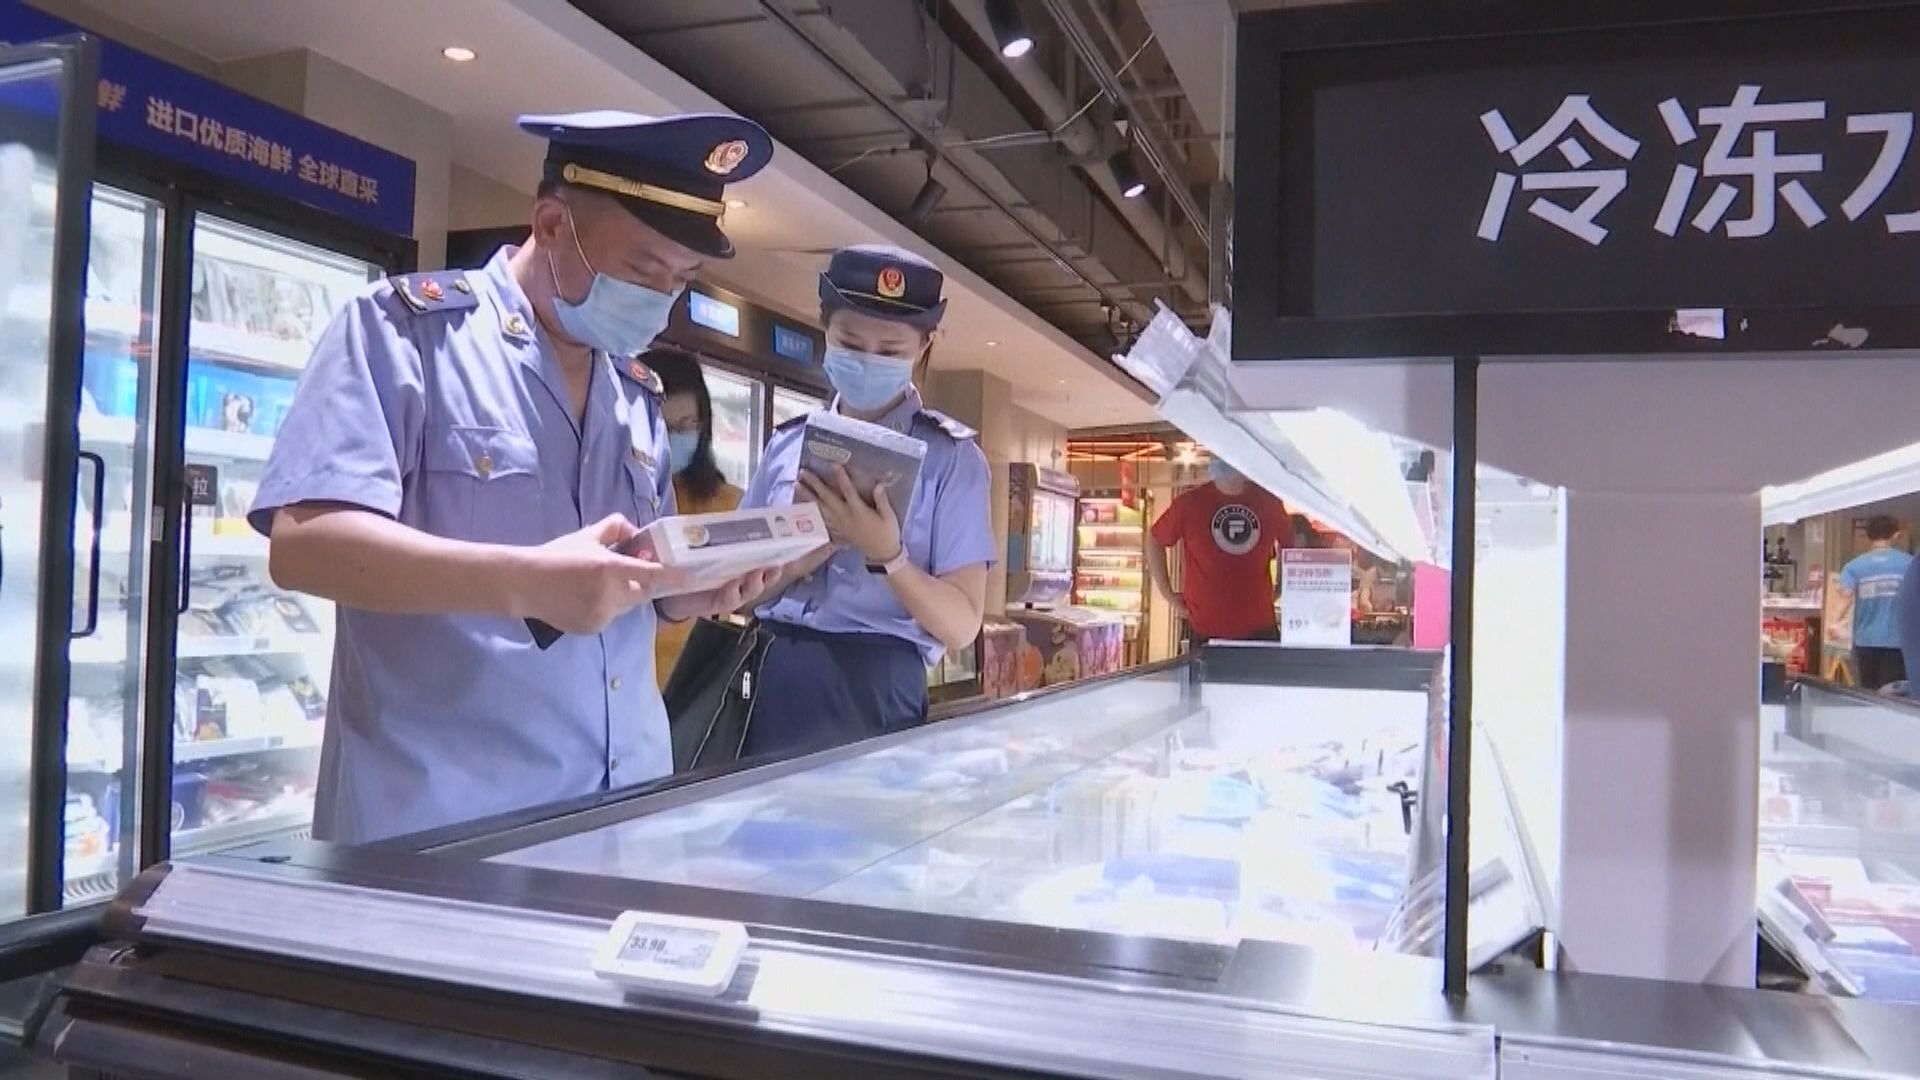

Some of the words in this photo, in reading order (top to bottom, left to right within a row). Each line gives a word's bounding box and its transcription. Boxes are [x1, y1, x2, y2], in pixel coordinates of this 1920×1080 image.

[147, 97, 293, 174] 进口优质海鲜
[298, 154, 380, 203] 全球直采
